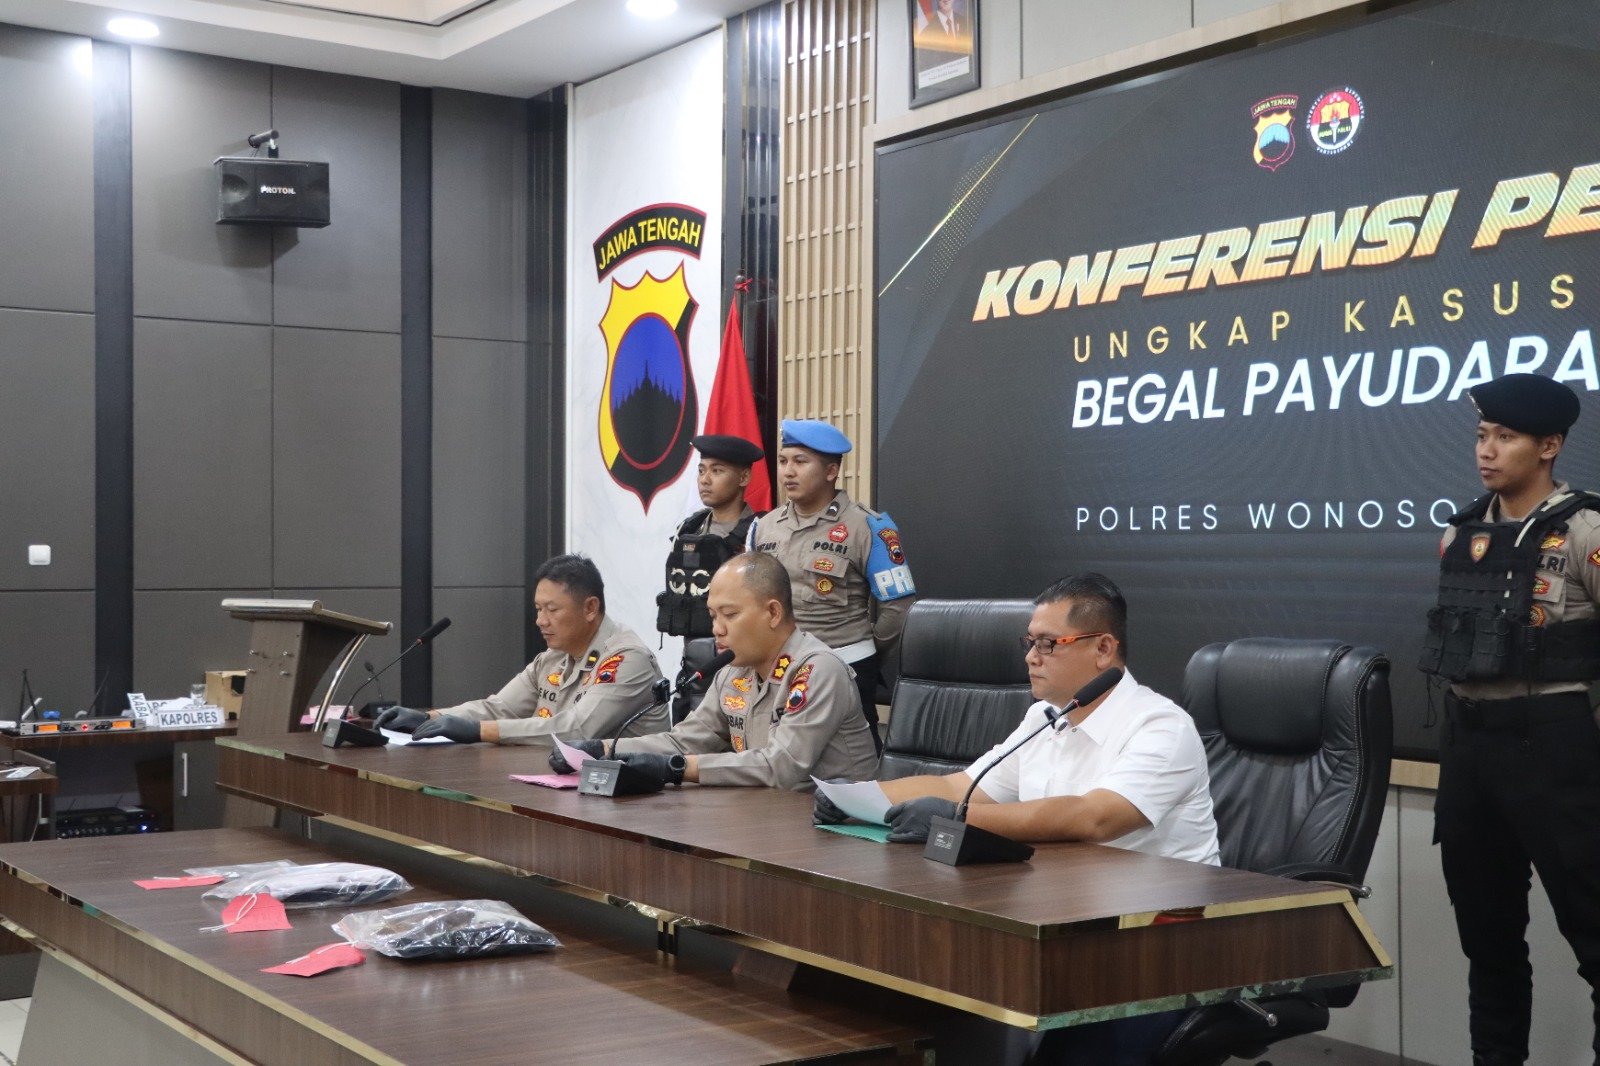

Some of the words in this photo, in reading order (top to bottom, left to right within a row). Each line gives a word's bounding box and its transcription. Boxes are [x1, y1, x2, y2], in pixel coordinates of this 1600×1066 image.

[1253, 102, 1271, 115] JAWA
[1270, 97, 1297, 109] TENGAH
[598, 226, 638, 270] JAWA
[637, 217, 702, 248] TENGAH
[972, 188, 1460, 322] KONFERENSI
[1074, 310, 1290, 363] UNGKAP
[1344, 273, 1576, 333] KASUS
[1071, 366, 1226, 429] BEGAL
[1241, 328, 1600, 418] PAYUDARA
[1076, 503, 1218, 531] POLRES
[1247, 497, 1460, 530] WONOSO
[813, 540, 848, 555] POLRI
[1536, 554, 1566, 573] LRI
[160, 711, 218, 726] KAPOLRES
